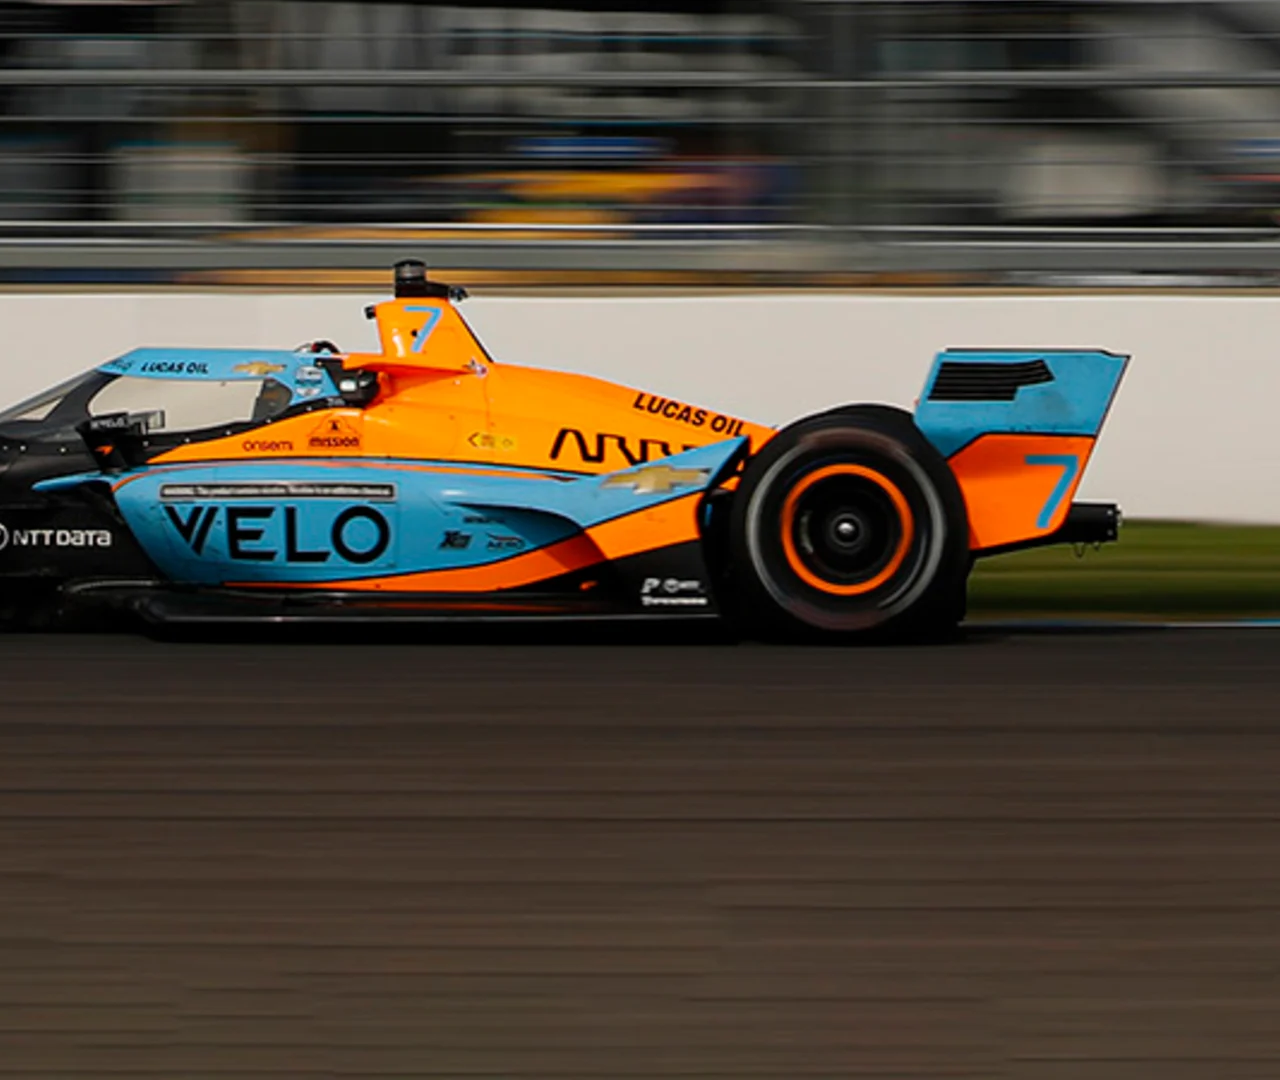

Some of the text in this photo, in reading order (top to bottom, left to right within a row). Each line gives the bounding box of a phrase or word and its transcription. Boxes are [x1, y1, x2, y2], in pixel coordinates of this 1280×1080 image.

[403, 305, 442, 353] 7
[140, 361, 184, 374] LUCAS
[185, 361, 208, 375] OIL
[632, 392, 745, 438] LUCAS OIL
[241, 439, 294, 452] onsemi
[1024, 454, 1079, 529] 7
[13, 528, 54, 546] NTT
[163, 504, 391, 564] VELO
